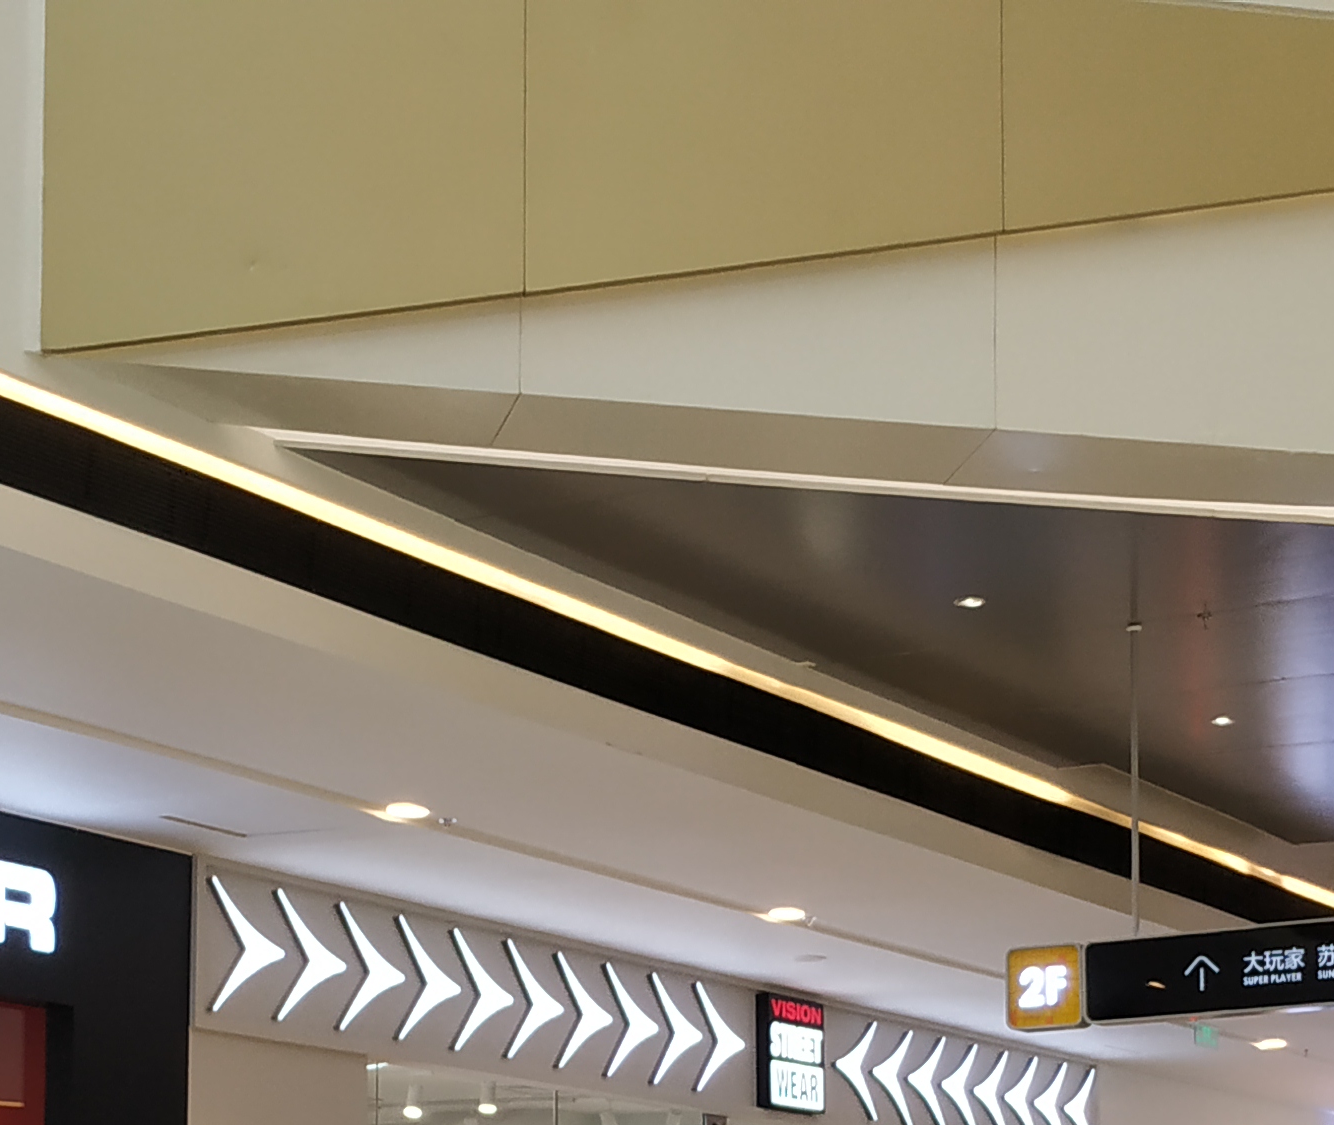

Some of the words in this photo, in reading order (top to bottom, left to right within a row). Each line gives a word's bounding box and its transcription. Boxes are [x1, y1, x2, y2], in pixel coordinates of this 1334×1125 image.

[1243, 946, 1305, 974] 大玩家
[1018, 965, 1068, 1008] 2F
[1243, 974, 1269, 986] SUPER
[1270, 972, 1302, 984] PLAYER
[770, 998, 823, 1026] VISION
[776, 1067, 819, 1103] WEAR
